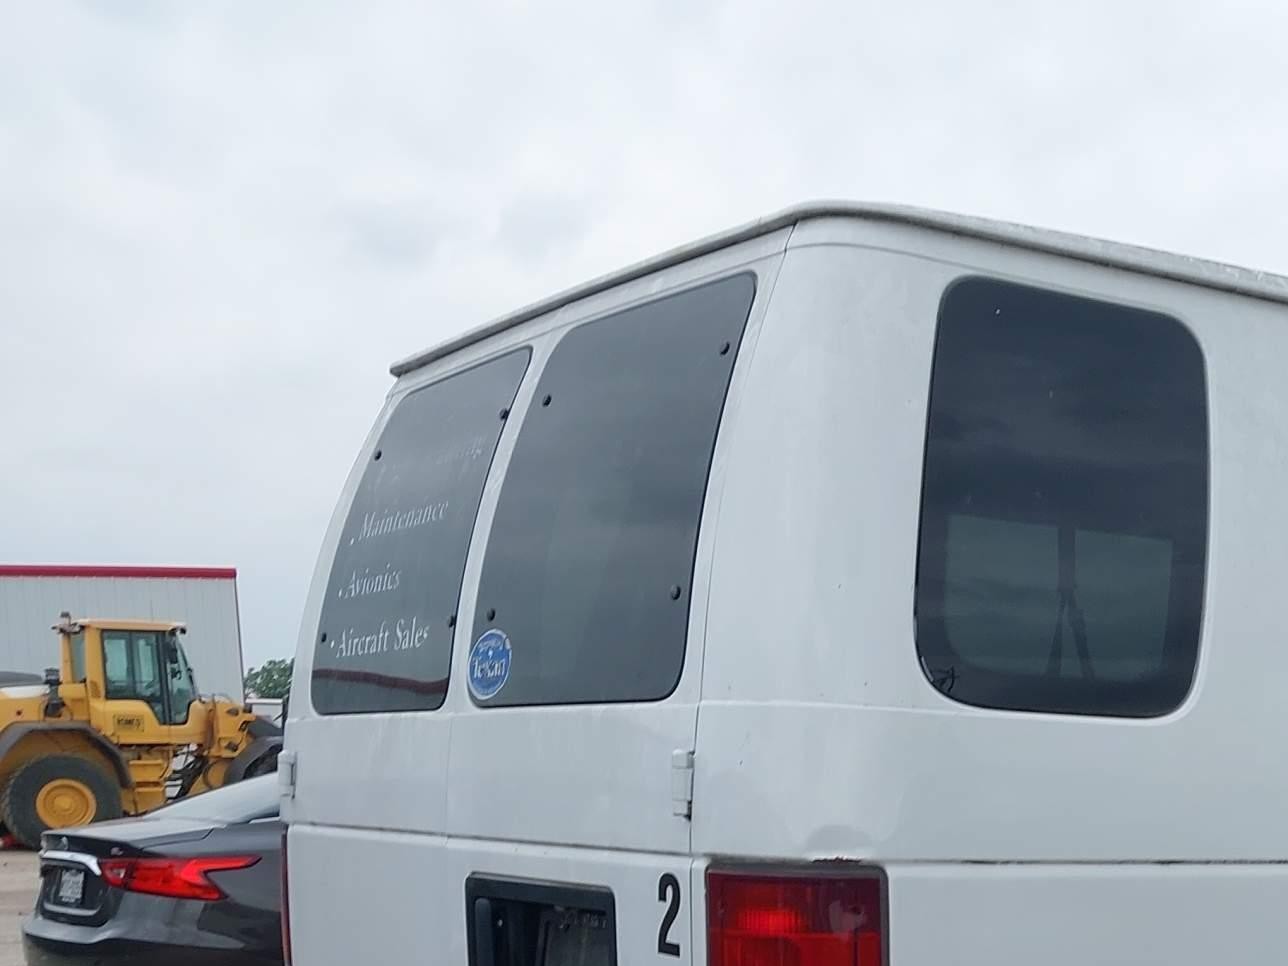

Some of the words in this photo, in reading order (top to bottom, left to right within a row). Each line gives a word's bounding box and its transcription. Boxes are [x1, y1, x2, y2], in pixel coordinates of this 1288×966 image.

[357, 502, 449, 540] Maintenance
[344, 563, 402, 599] Avionics
[336, 620, 389, 659] Aircraft
[657, 872, 680, 957] 2
